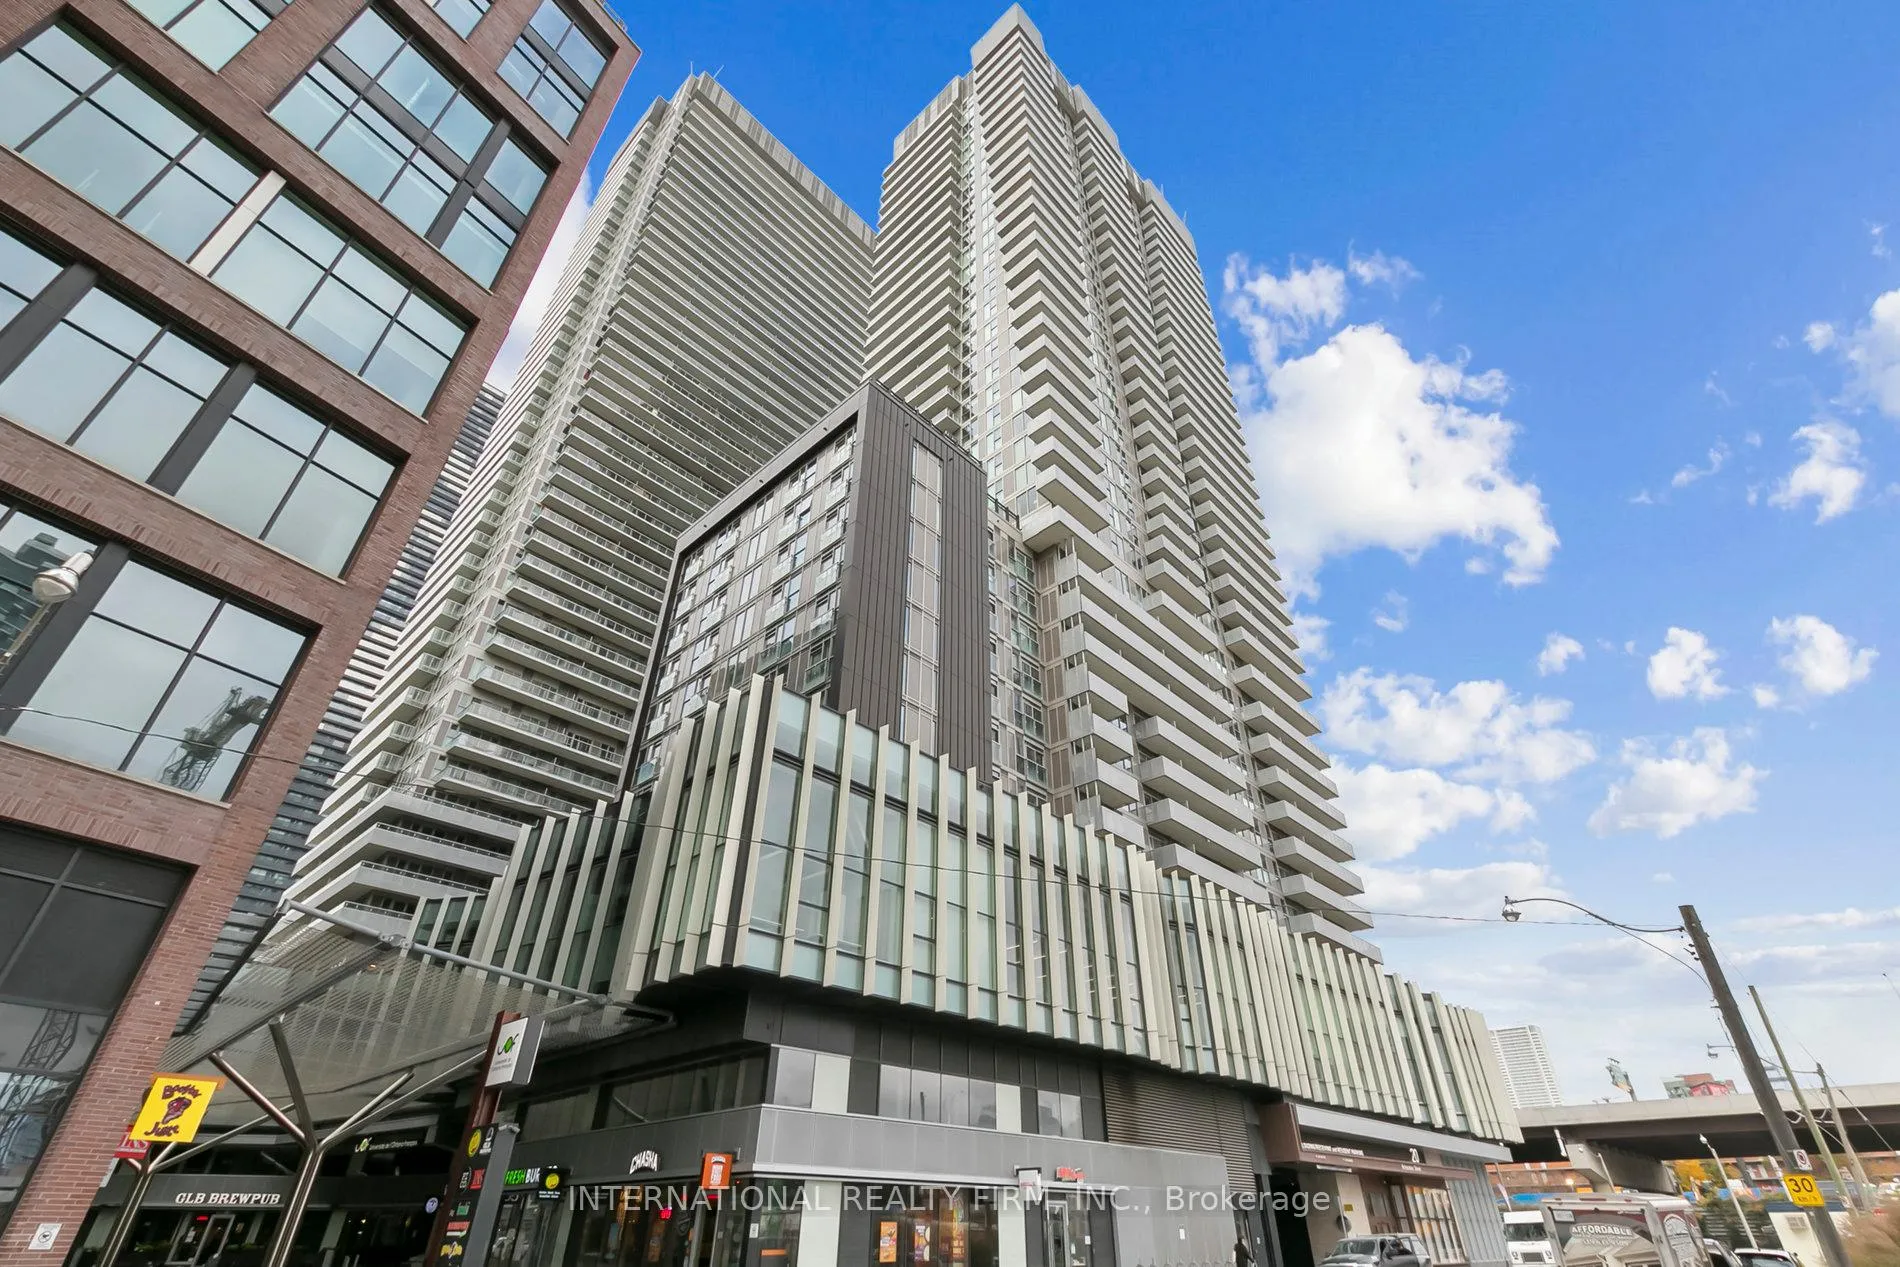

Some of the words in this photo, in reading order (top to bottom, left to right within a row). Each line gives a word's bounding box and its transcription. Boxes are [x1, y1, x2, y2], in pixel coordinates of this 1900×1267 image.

[504, 1169, 526, 1184] FRESH
[1789, 1178, 1813, 1192] 30
[175, 1192, 206, 1204] GLB
[208, 1193, 281, 1205] BREWPUB
[1571, 1224, 1634, 1236] AFFORDABLE
